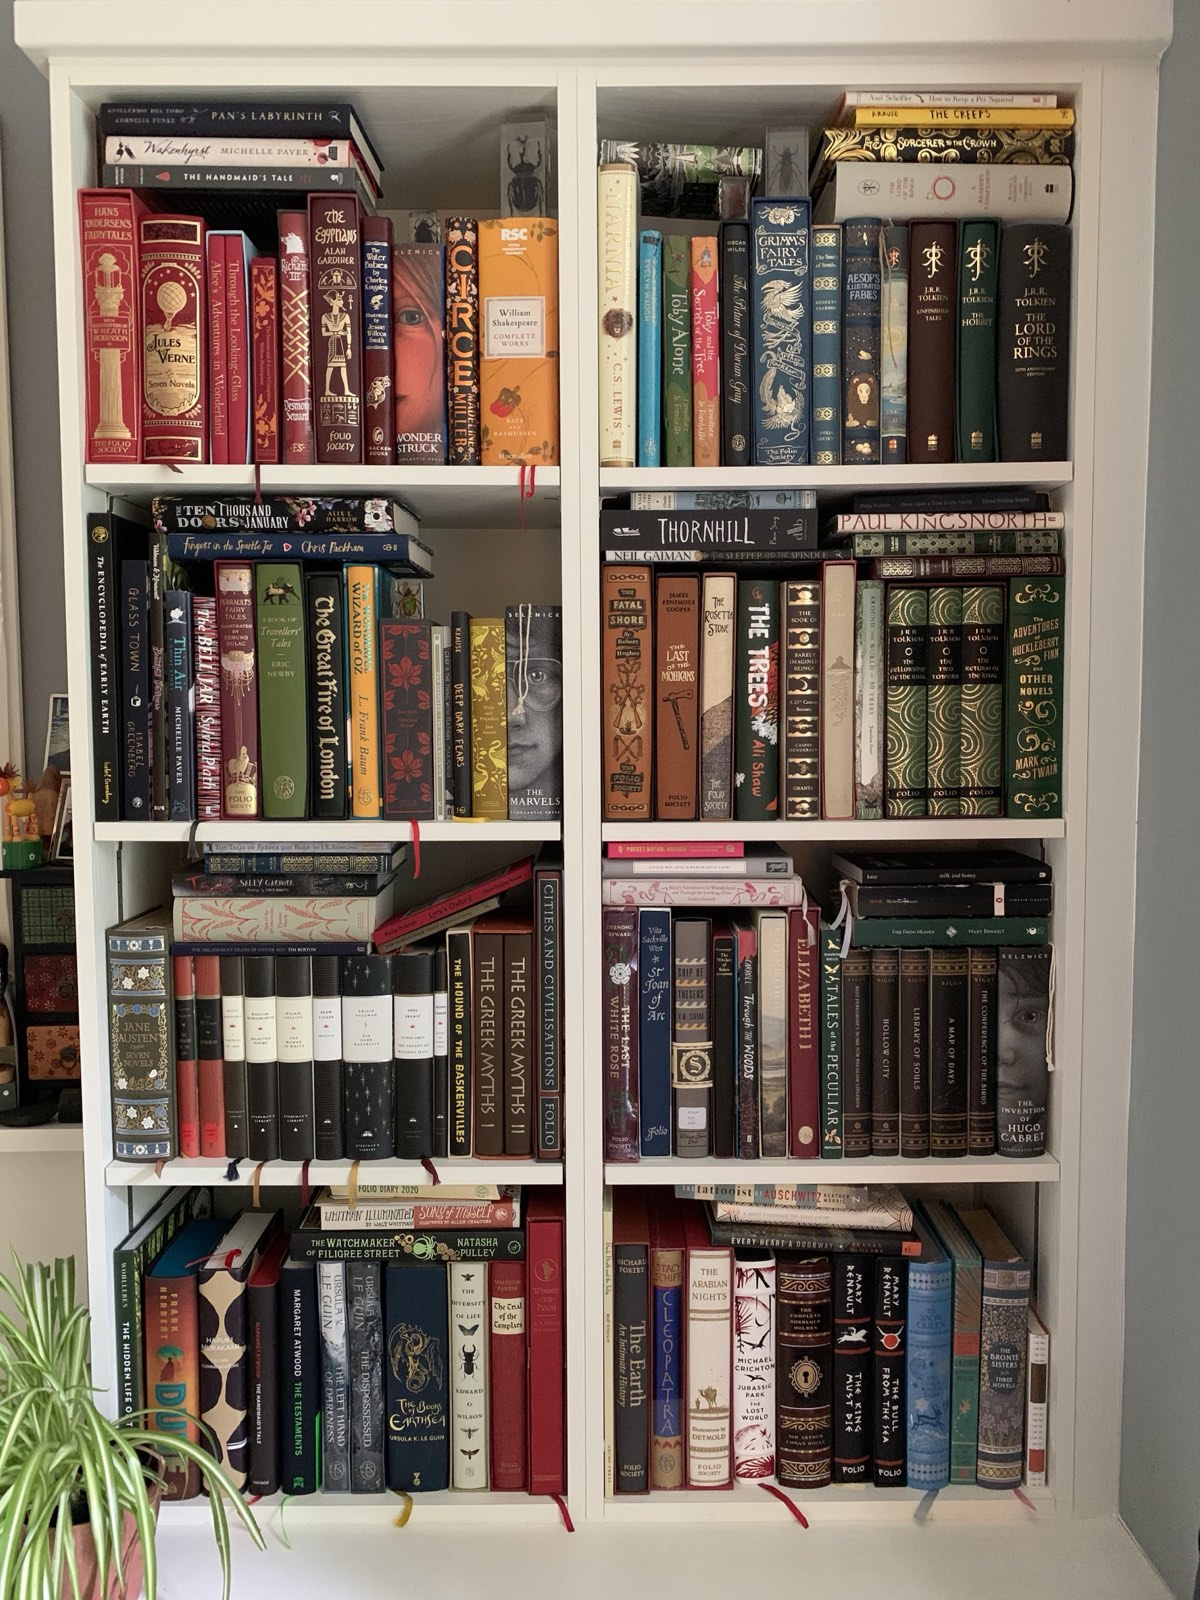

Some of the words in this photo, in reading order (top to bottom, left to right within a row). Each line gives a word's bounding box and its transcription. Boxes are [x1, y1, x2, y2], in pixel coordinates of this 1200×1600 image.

[212, 110, 246, 120] PAN'S
[252, 110, 322, 121] LABYRINTH
[930, 110, 948, 120] THE
[954, 110, 991, 119] CREEPS
[144, 140, 212, 164] Wakenhyrst
[220, 148, 273, 156] MICHELLE
[277, 148, 308, 156] PAVER
[206, 173, 268, 182] HANDMAID'S
[272, 174, 293, 182] TALE
[94, 208, 118, 216] HANS
[501, 229, 527, 240] RSC
[759, 236, 805, 246] GRIMM'S
[760, 248, 799, 259] FAIRY
[767, 258, 802, 267] TALES
[211, 260, 221, 294] Alice's
[847, 274, 880, 284] AESOP'S
[733, 275, 746, 296] The
[1024, 288, 1047, 296] J.R.R.
[1015, 298, 1055, 306] TOLKIEN
[450, 246, 475, 387] CIRCE
[499, 309, 531, 317] William
[668, 290, 688, 331] Toby
[732, 296, 746, 328] Picture
[1025, 313, 1046, 321] THE
[212, 300, 223, 355] Adventures
[492, 319, 537, 327] Shakespeare
[1015, 323, 1055, 336] LORD
[147, 334, 181, 351] JULES
[1017, 337, 1032, 345] OF
[1034, 337, 1053, 345] THE
[158, 349, 195, 364] VERNE
[672, 328, 689, 375] Alone
[1013, 347, 1057, 360] RINGS
[213, 361, 223, 370] in
[734, 343, 746, 377] Dorian
[613, 363, 623, 386] C.S.
[148, 380, 167, 389] Seven
[169, 380, 195, 389] Novels
[729, 380, 747, 403] Gray
[213, 375, 224, 436] Wonderland
[613, 392, 623, 429] LEWIS
[466, 393, 474, 446] MADELINE
[841, 515, 892, 530] PAUL
[900, 514, 1047, 530] KINGSNORTH
[658, 517, 755, 544] THORNHILL
[614, 552, 642, 560] NEIL
[644, 552, 692, 560] GAIMAN
[98, 569, 107, 652] ENCYCLOPEDIA
[129, 588, 139, 627] GLASS
[613, 601, 642, 609] FATAL
[610, 616, 644, 625] SHORE
[748, 603, 770, 638] THE
[175, 636, 185, 666] Thin
[271, 639, 291, 647] Tales
[129, 633, 140, 672] TOWN
[666, 651, 689, 662] LAST
[175, 673, 186, 691] Air
[748, 646, 770, 707] TREES
[1020, 675, 1053, 683] OTHER
[454, 683, 464, 707] DEEP
[1020, 687, 1053, 695] NOVELS
[455, 711, 464, 735] DARK
[202, 716, 214, 754] Sylvia
[455, 738, 464, 768] FEARS
[753, 740, 765, 757] Ali
[1015, 758, 1038, 770] MARK
[1033, 764, 1057, 778] TWAIN
[202, 757, 215, 790] Plath
[752, 762, 765, 797] Shaw
[511, 797, 560, 805] MARVELS
[544, 885, 553, 932] CITIES
[544, 938, 553, 969] AND
[678, 968, 693, 977] SHIP
[695, 968, 704, 977] OF
[454, 982, 464, 1019] HOUND
[610, 996, 619, 1041] WHITE
[124, 1023, 150, 1031] JANE
[456, 1025, 462, 1033] OF
[544, 975, 554, 1086] CIVILISATIONS
[118, 1034, 158, 1042] AUSTEN
[611, 1047, 619, 1078] ROSE
[455, 1064, 464, 1144] BASKERVILLES
[545, 1104, 554, 1145] FOLIO
[1008, 1124, 1040, 1132] HUGO
[1001, 1132, 1044, 1142] CABRET
[358, 1185, 377, 1193] FOLIO
[380, 1185, 399, 1193] DIARY
[401, 1185, 419, 1194] 2020
[697, 1186, 752, 1198] tattooist
[763, 1189, 822, 1202] AUSCHWITZ
[327, 1238, 395, 1247] WATCHMAKER
[457, 1238, 498, 1246] NATASHA
[760, 1239, 785, 1247] HEART
[796, 1240, 833, 1249] DOORWAY
[318, 1249, 363, 1258] FILIGREE
[364, 1249, 399, 1257] STREET
[460, 1248, 495, 1257] PULLEY
[692, 1280, 728, 1288] ARABIAN
[854, 1273, 862, 1304] MARY
[883, 1267, 891, 1317] RENAULT
[630, 1320, 645, 1354] The
[661, 1290, 674, 1435] CLEOPATRA
[735, 1364, 775, 1372] CRICHTON
[992, 1360, 1017, 1368] SISTERS
[630, 1359, 646, 1407] Earth
[737, 1383, 772, 1391] JURASSIC
[845, 1414, 853, 1432] DIE
